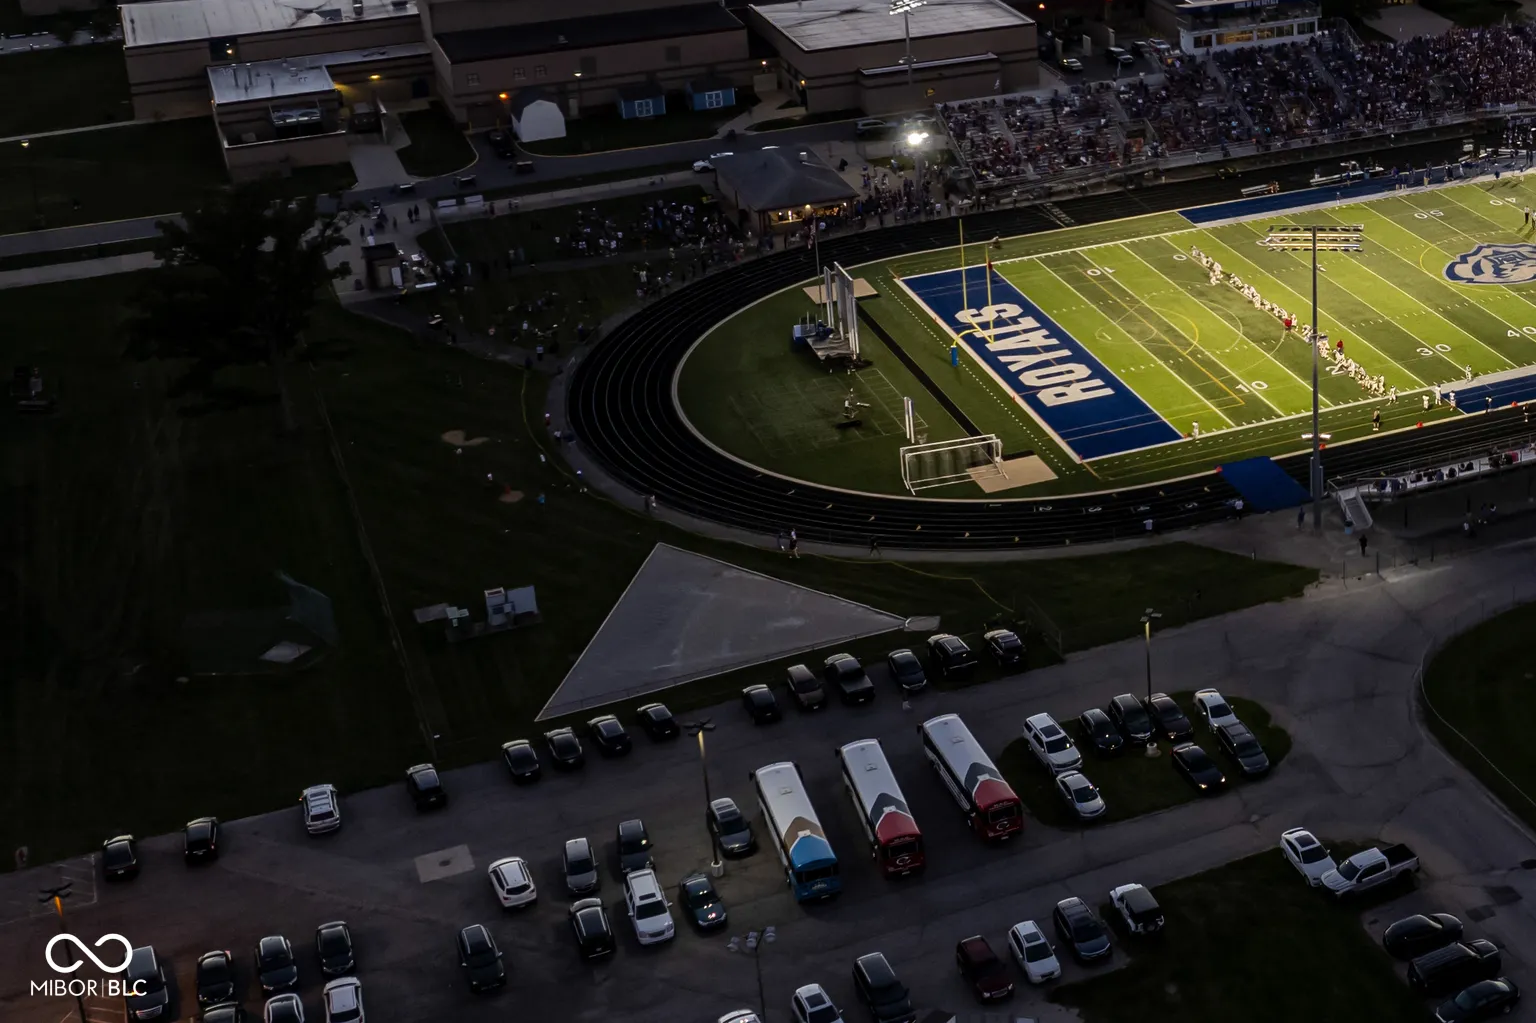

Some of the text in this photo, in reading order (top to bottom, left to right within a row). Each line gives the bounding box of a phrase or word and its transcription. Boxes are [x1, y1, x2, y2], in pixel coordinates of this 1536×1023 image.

[954, 303, 1116, 407] ROYALS
[1416, 343, 1451, 357] 30
[1235, 380, 1268, 393] 10
